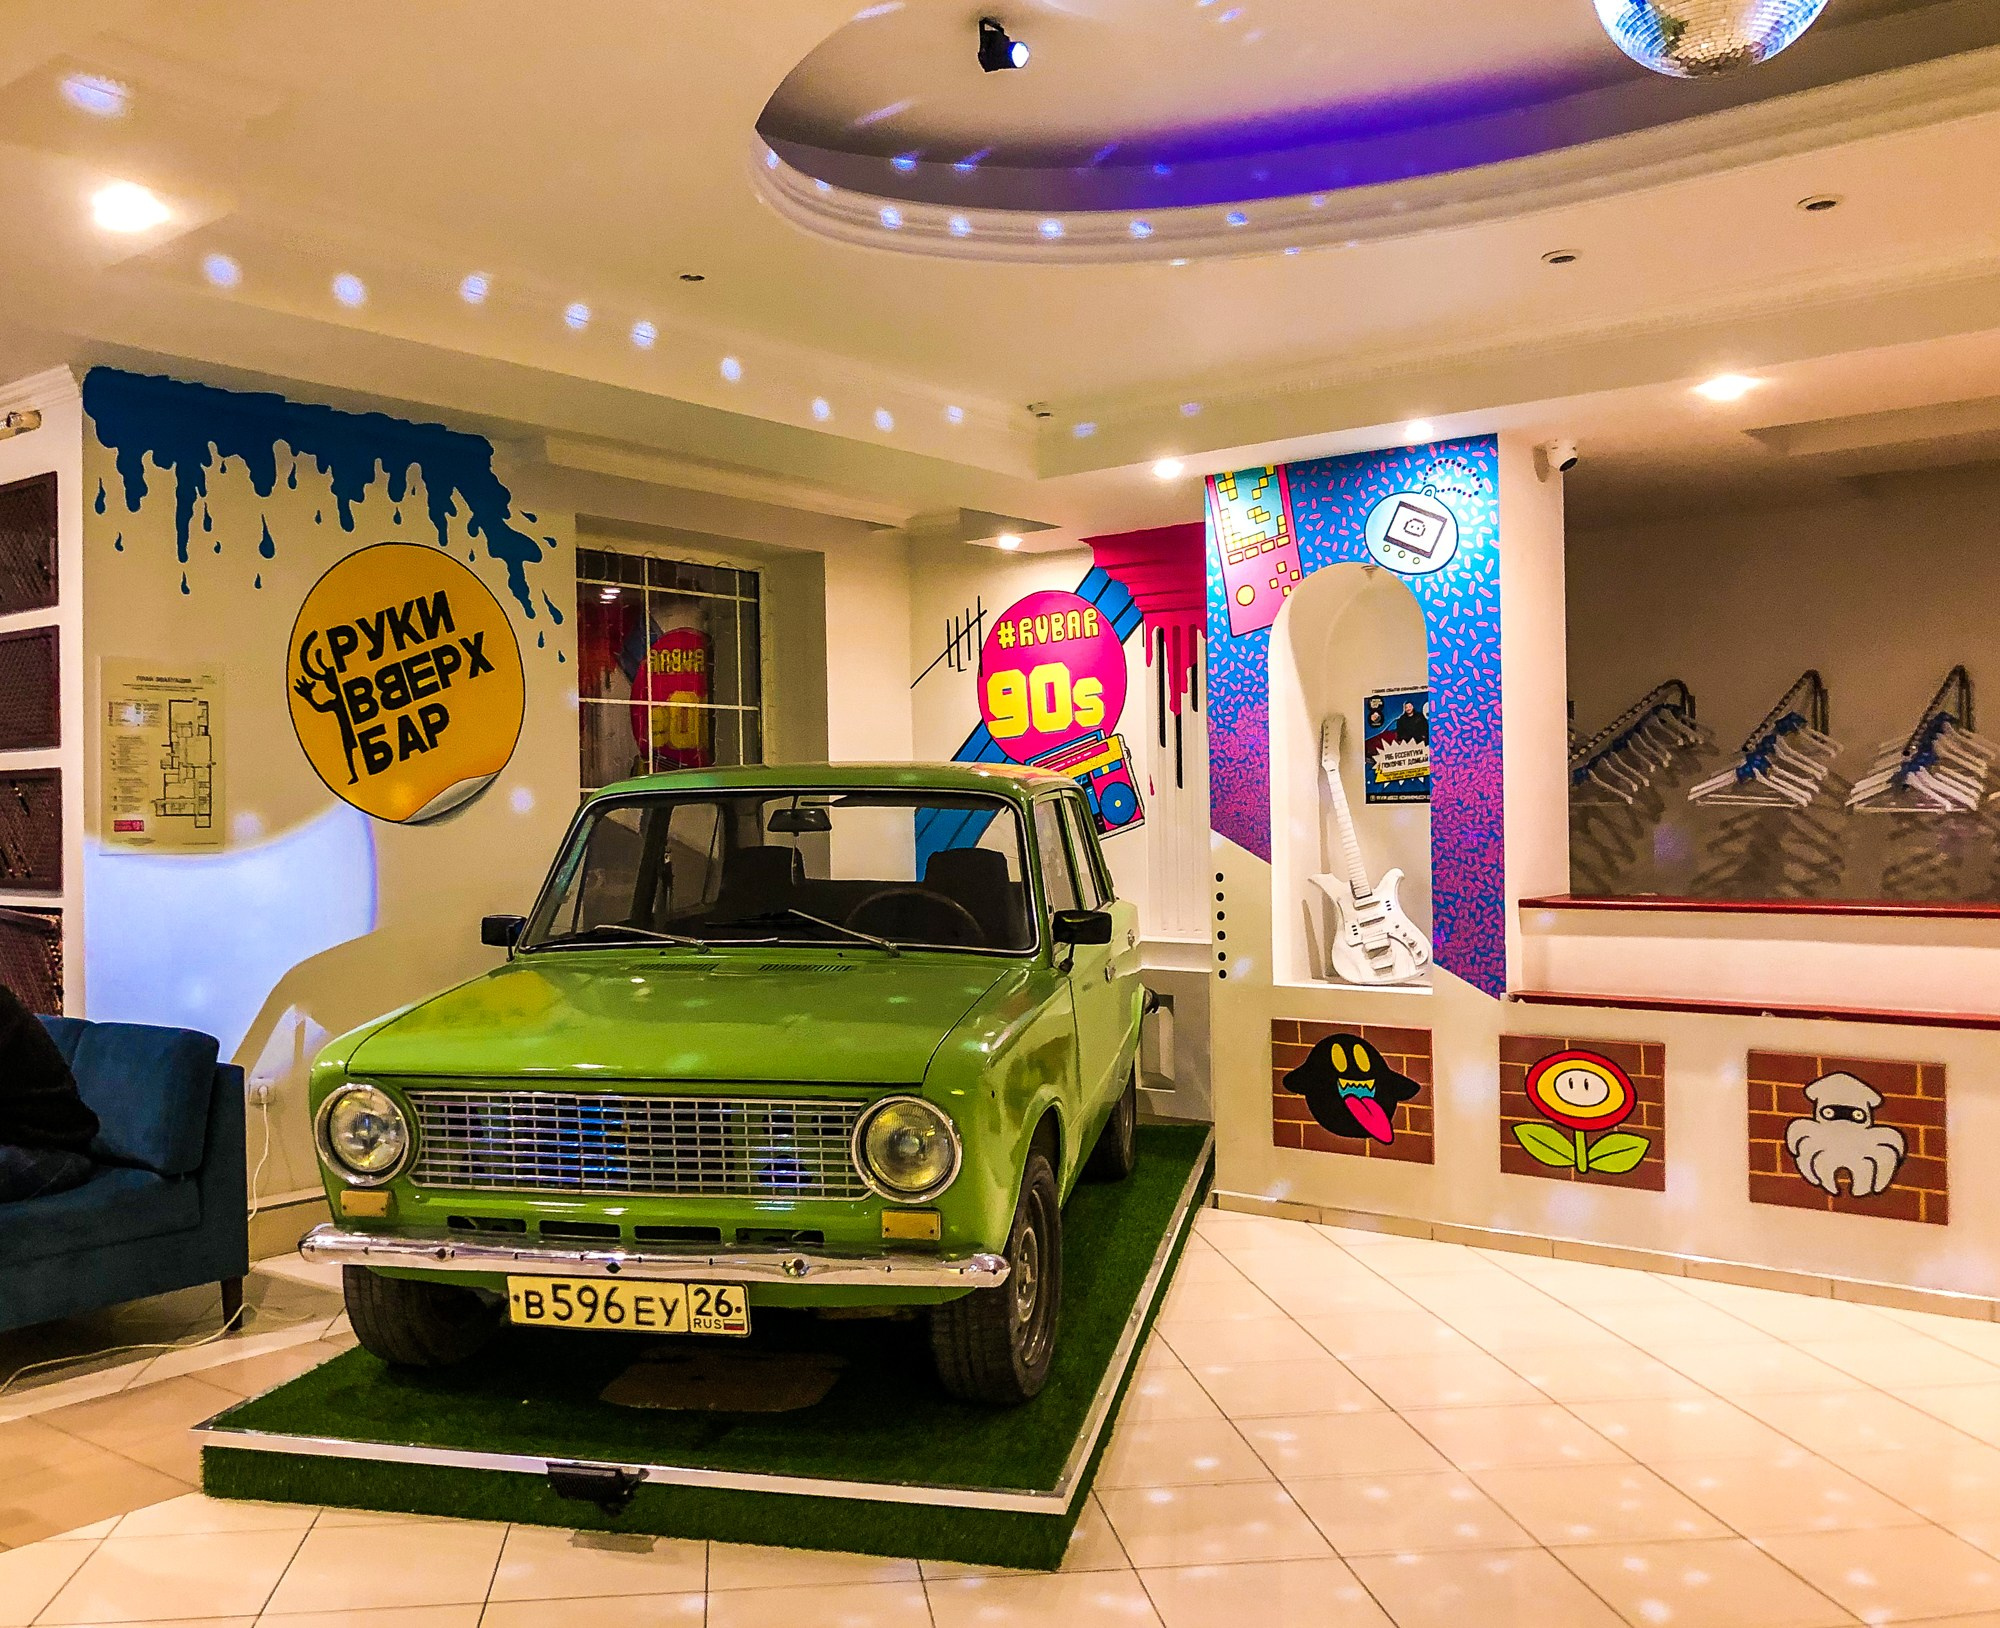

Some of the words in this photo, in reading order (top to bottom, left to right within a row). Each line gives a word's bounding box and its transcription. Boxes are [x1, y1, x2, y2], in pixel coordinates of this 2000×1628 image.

[326, 590, 455, 673] РУКИ
[997, 607, 1100, 649] #RVBAR
[342, 631, 495, 725] ВВЕРХ
[986, 661, 1105, 739] 90s
[357, 702, 450, 776] БАР
[693, 1287, 734, 1318] 26
[693, 1318, 722, 1330] RUS
